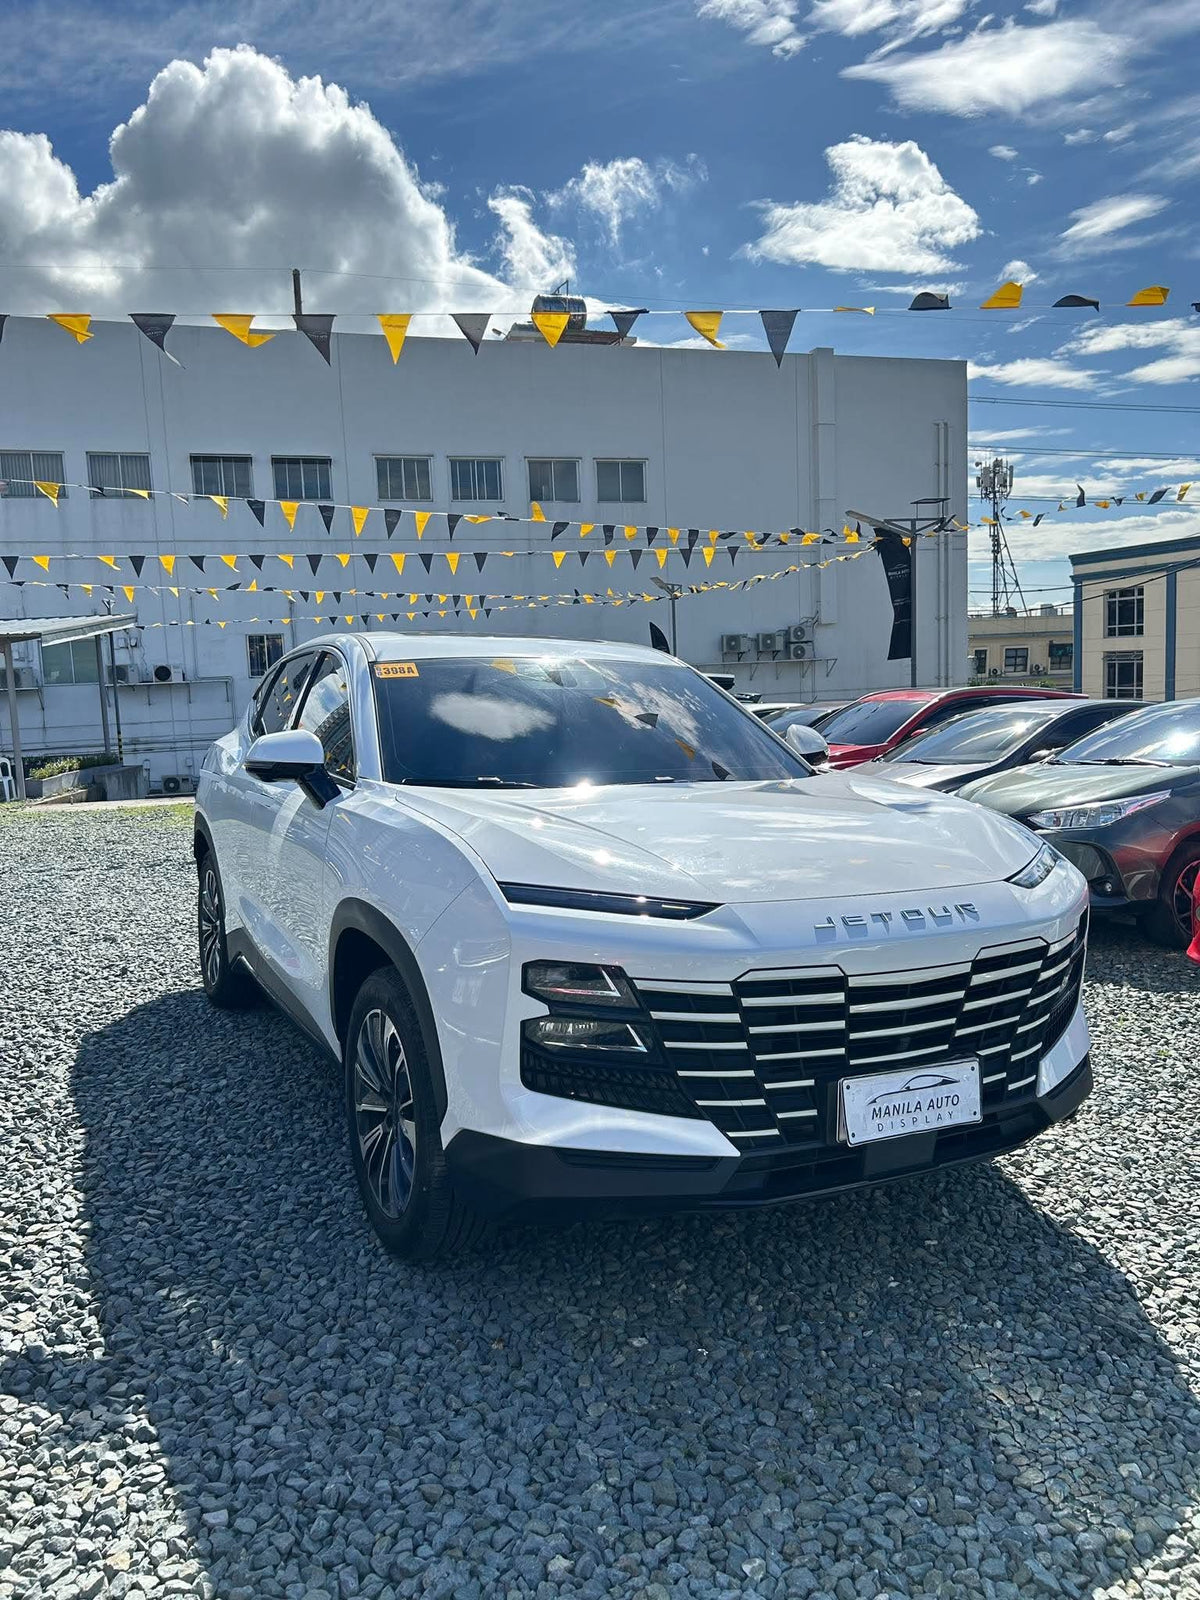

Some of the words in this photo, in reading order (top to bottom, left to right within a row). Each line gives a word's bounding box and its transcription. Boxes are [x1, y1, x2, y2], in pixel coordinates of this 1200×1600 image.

[383, 666, 415, 675] 398A
[814, 901, 979, 930] JETOUR
[871, 1099, 923, 1120] MANILA
[926, 1093, 961, 1111] AUTO
[877, 1110, 955, 1132] DISPLAY
